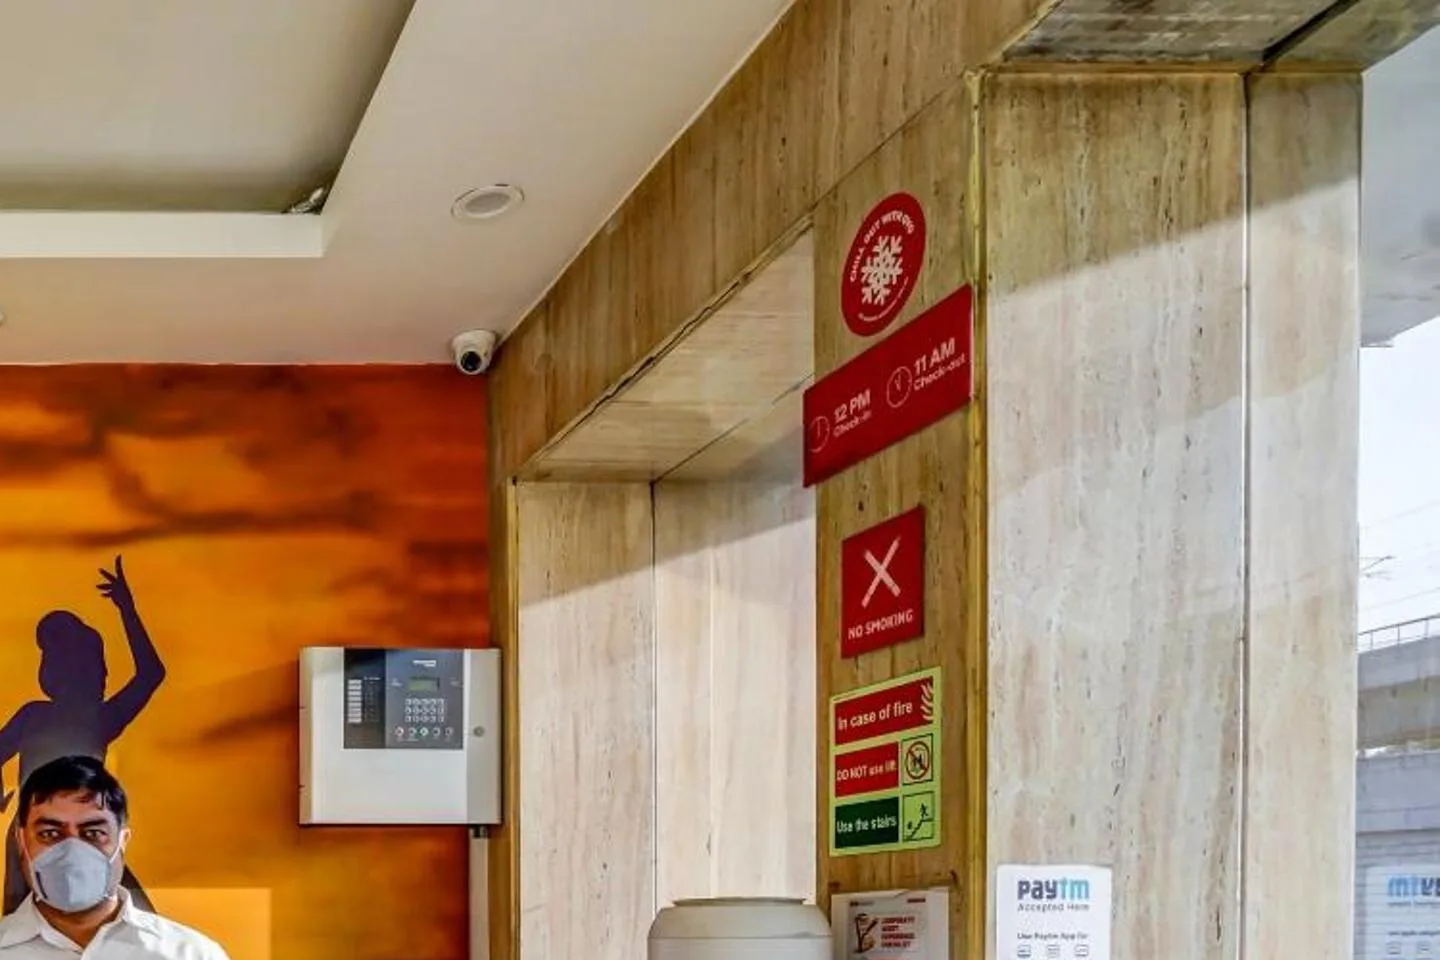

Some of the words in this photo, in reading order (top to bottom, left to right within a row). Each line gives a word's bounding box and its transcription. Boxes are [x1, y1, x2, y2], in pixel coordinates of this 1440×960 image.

[914, 354, 927, 375] 11
[930, 337, 956, 367] AM
[913, 352, 966, 391] Check-out
[834, 403, 848, 424] 12
[850, 388, 871, 415] PM
[848, 624, 863, 640] NO
[865, 609, 913, 635] SMOKING
[838, 716, 848, 731] In
[850, 711, 876, 727] case
[879, 703, 892, 721] of
[893, 701, 913, 718] fire
[837, 767, 849, 782] DO
[850, 765, 868, 779] NOT
[869, 765, 884, 776] use
[837, 820, 853, 834] Use
[855, 817, 869, 832] the
[871, 815, 898, 830] stairs
[1017, 903, 1065, 912] Accepted
[1034, 932, 1059, 941] Paytm
